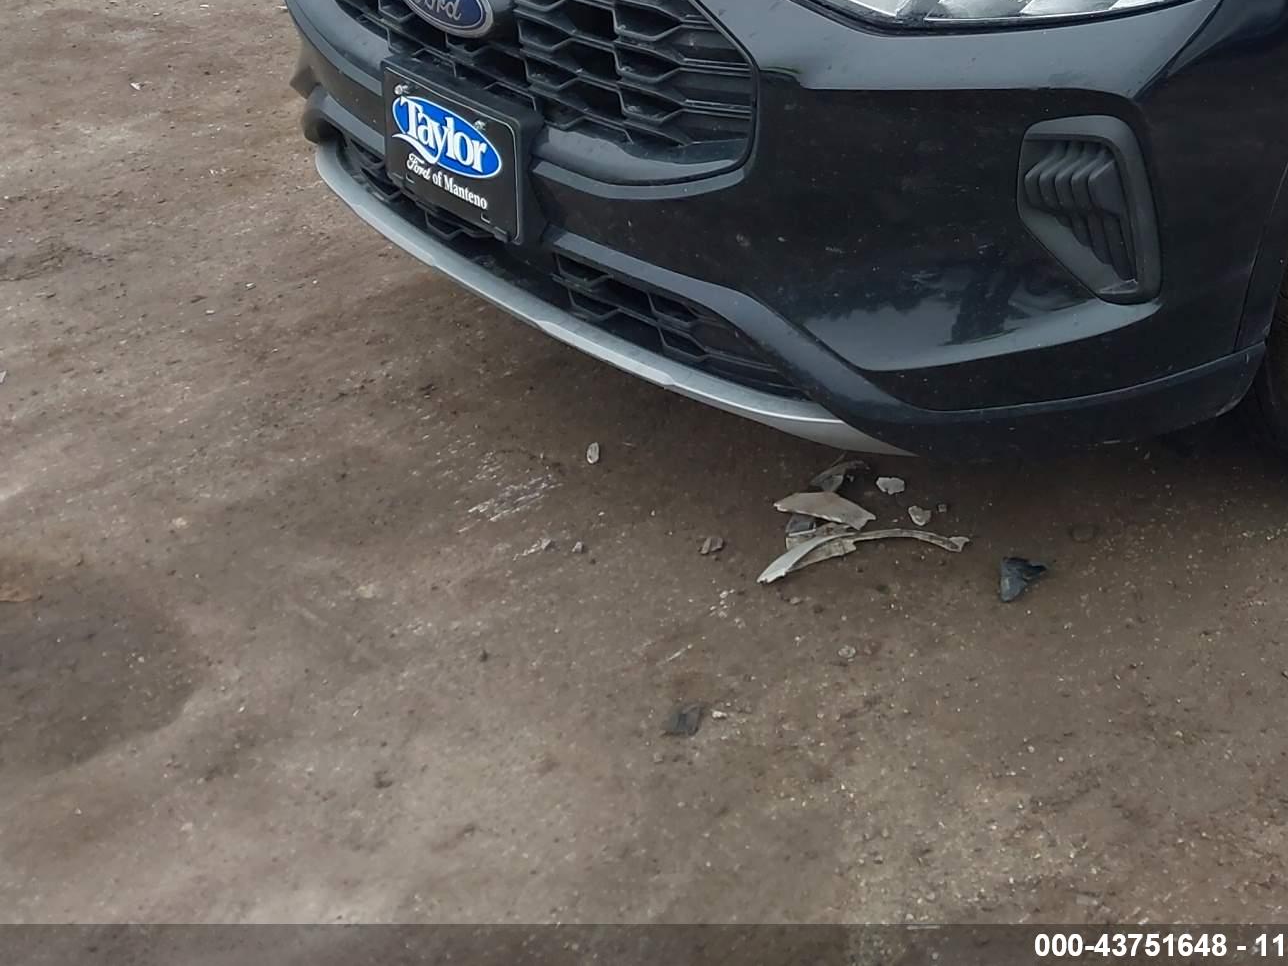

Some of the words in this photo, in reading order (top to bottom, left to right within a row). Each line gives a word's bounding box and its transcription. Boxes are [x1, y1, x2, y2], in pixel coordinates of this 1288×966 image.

[392, 96, 488, 173] Taylor
[406, 153, 431, 180] Ford
[432, 172, 443, 187] of
[443, 175, 488, 210] Manteno
